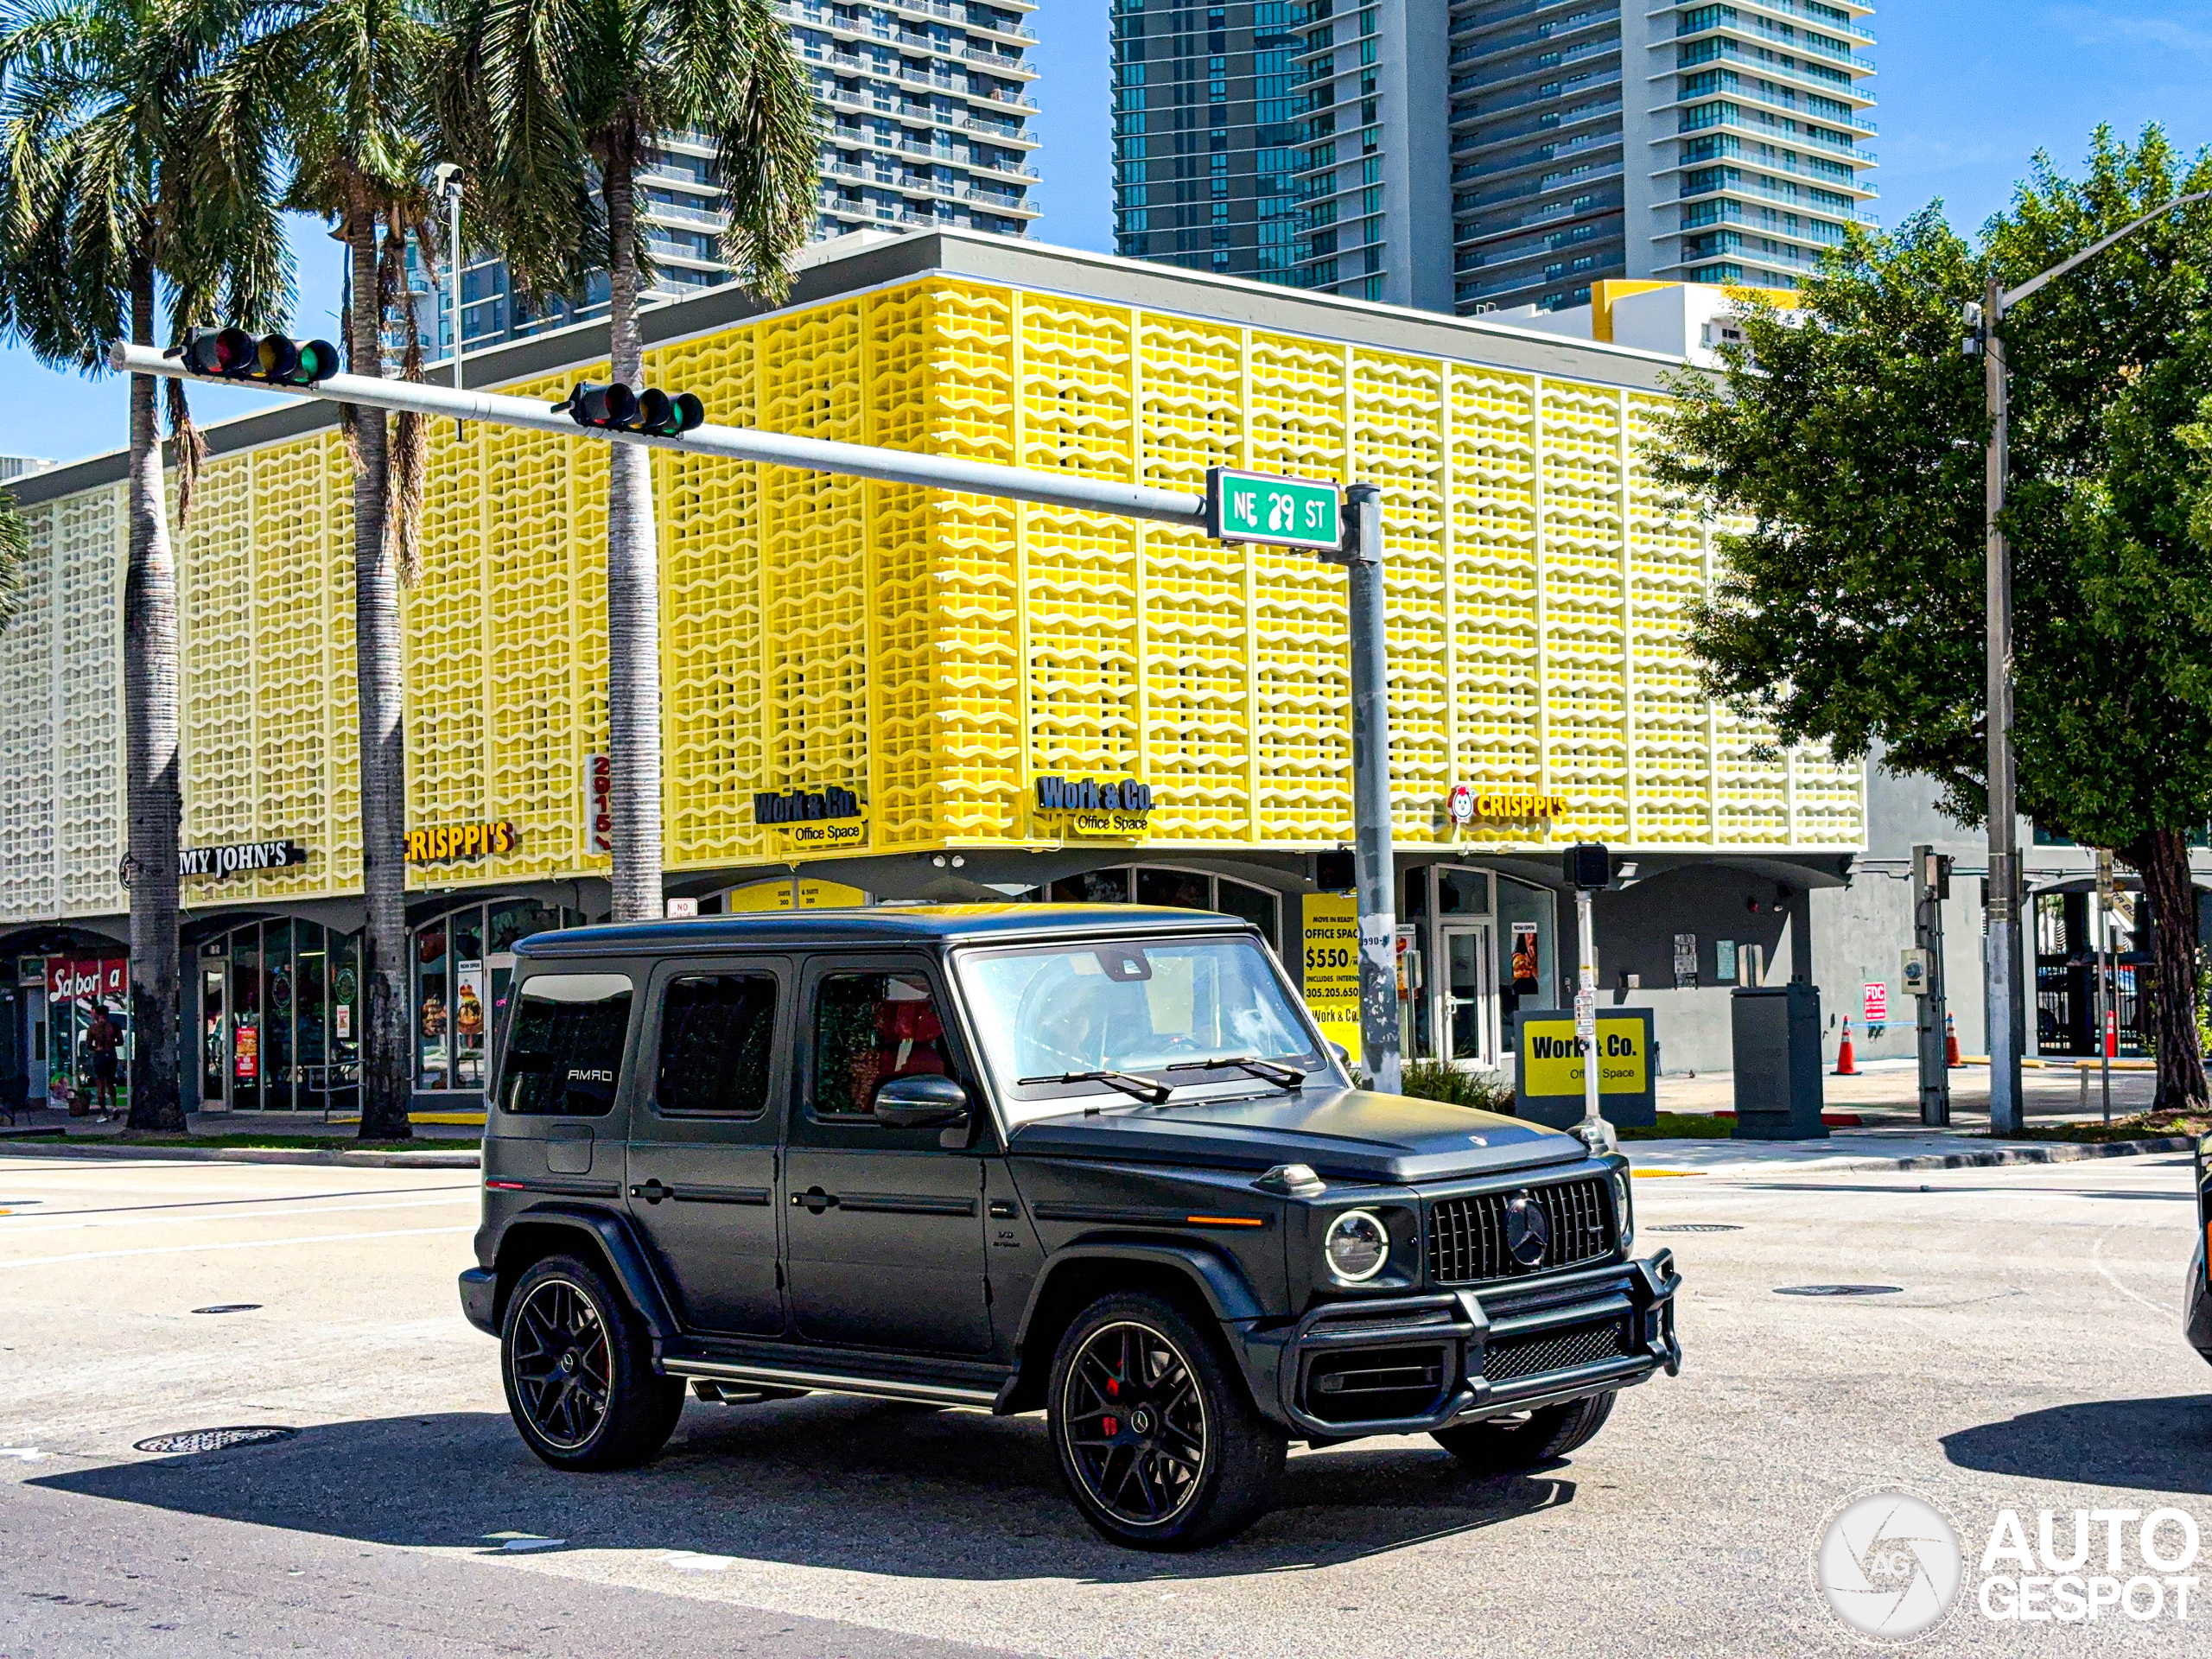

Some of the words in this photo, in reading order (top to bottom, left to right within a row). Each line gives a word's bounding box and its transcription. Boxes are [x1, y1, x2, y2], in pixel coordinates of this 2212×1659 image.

[1234, 491, 1258, 528] NE
[1268, 492, 1295, 532] 29
[1306, 499, 1326, 529] ST
[1038, 776, 1100, 810] Work
[1102, 782, 1121, 810] &
[1121, 778, 1156, 810] Co.
[754, 790, 804, 824] Work
[807, 792, 824, 820] &
[825, 785, 861, 819] Co.
[1477, 793, 1568, 817] CRISPPI'S
[1077, 815, 1110, 830] Office
[1114, 815, 1148, 833] Space
[795, 826, 825, 842] Office
[827, 825, 860, 841] Space
[677, 902, 689, 912] NO
[1305, 928, 1335, 939] OFFICE
[1306, 946, 1348, 970] $550
[49, 969, 101, 1002] Sabor
[109, 969, 121, 988] a
[1306, 975, 1334, 983] INCLUDES
[1866, 985, 1885, 1001] FDC
[1312, 1009, 1336, 1023] Work
[1337, 1010, 1344, 1022] &
[1532, 1035, 1586, 1059] Work
[1606, 1033, 1637, 1058] Co.
[1602, 1068, 1635, 1080] Space
